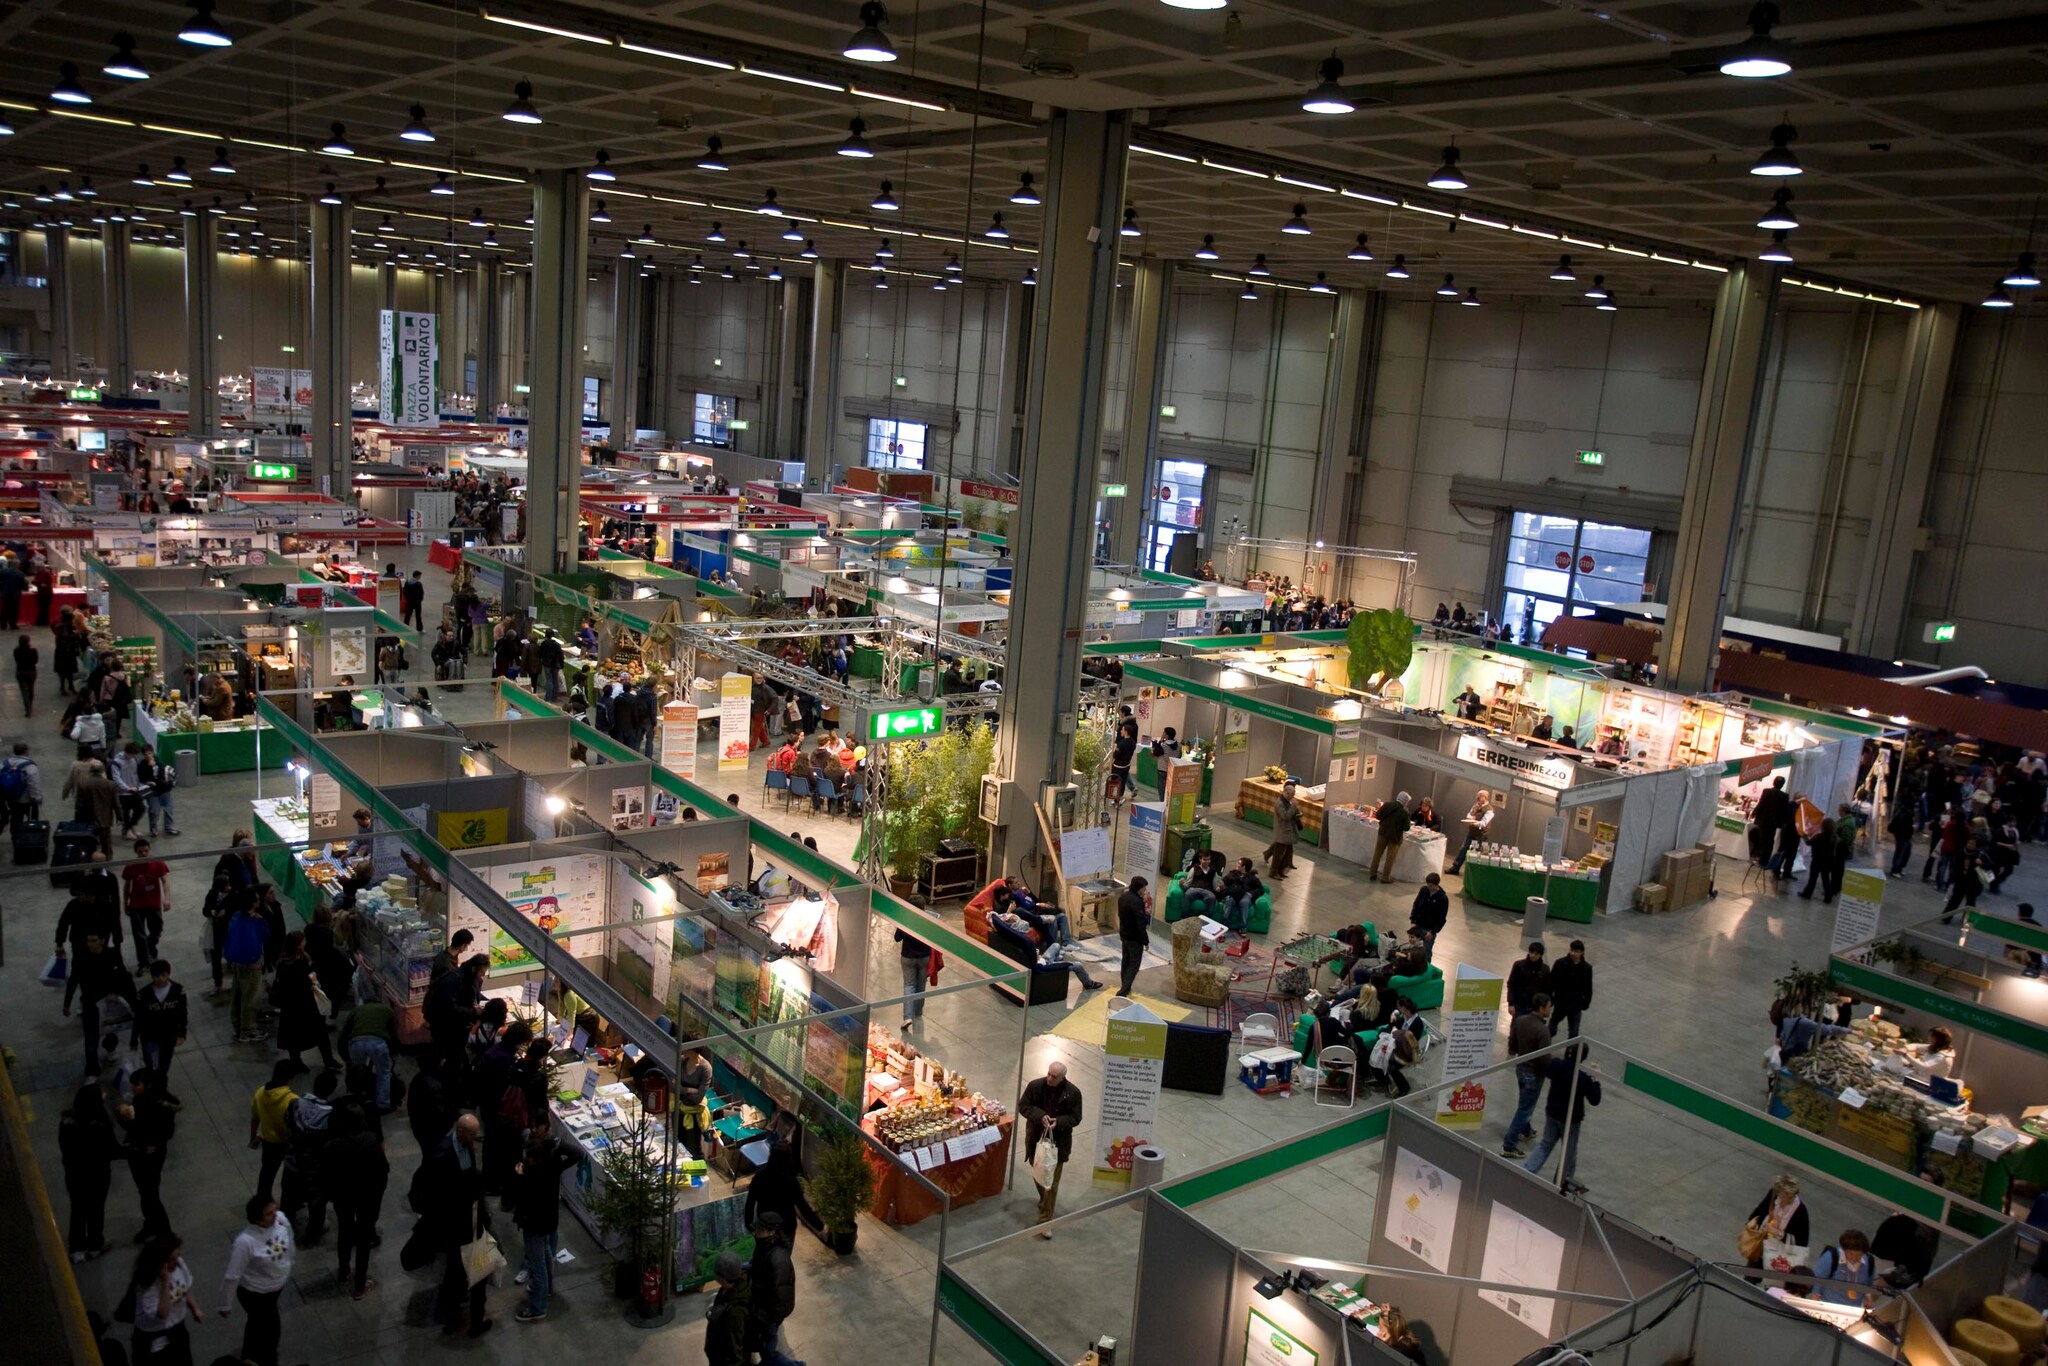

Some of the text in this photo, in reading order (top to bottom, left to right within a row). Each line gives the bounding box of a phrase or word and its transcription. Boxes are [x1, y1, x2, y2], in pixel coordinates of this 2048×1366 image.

[254, 368, 284, 376] NGRESSO
[418, 317, 431, 423] VOLONTARIATO
[407, 382, 417, 423] PIAZZA
[972, 485, 1018, 503] Snack Ca
[1555, 556, 1571, 566] STOP
[1579, 560, 1595, 568] STOP
[1469, 747, 1567, 780] TERREDIMEZZO
[660, 803, 673, 812] 23
[506, 887, 543, 899] Lombardia
[1112, 1023, 1137, 1032] Mangia
[1455, 1098, 1484, 1111] GIUSTA!
